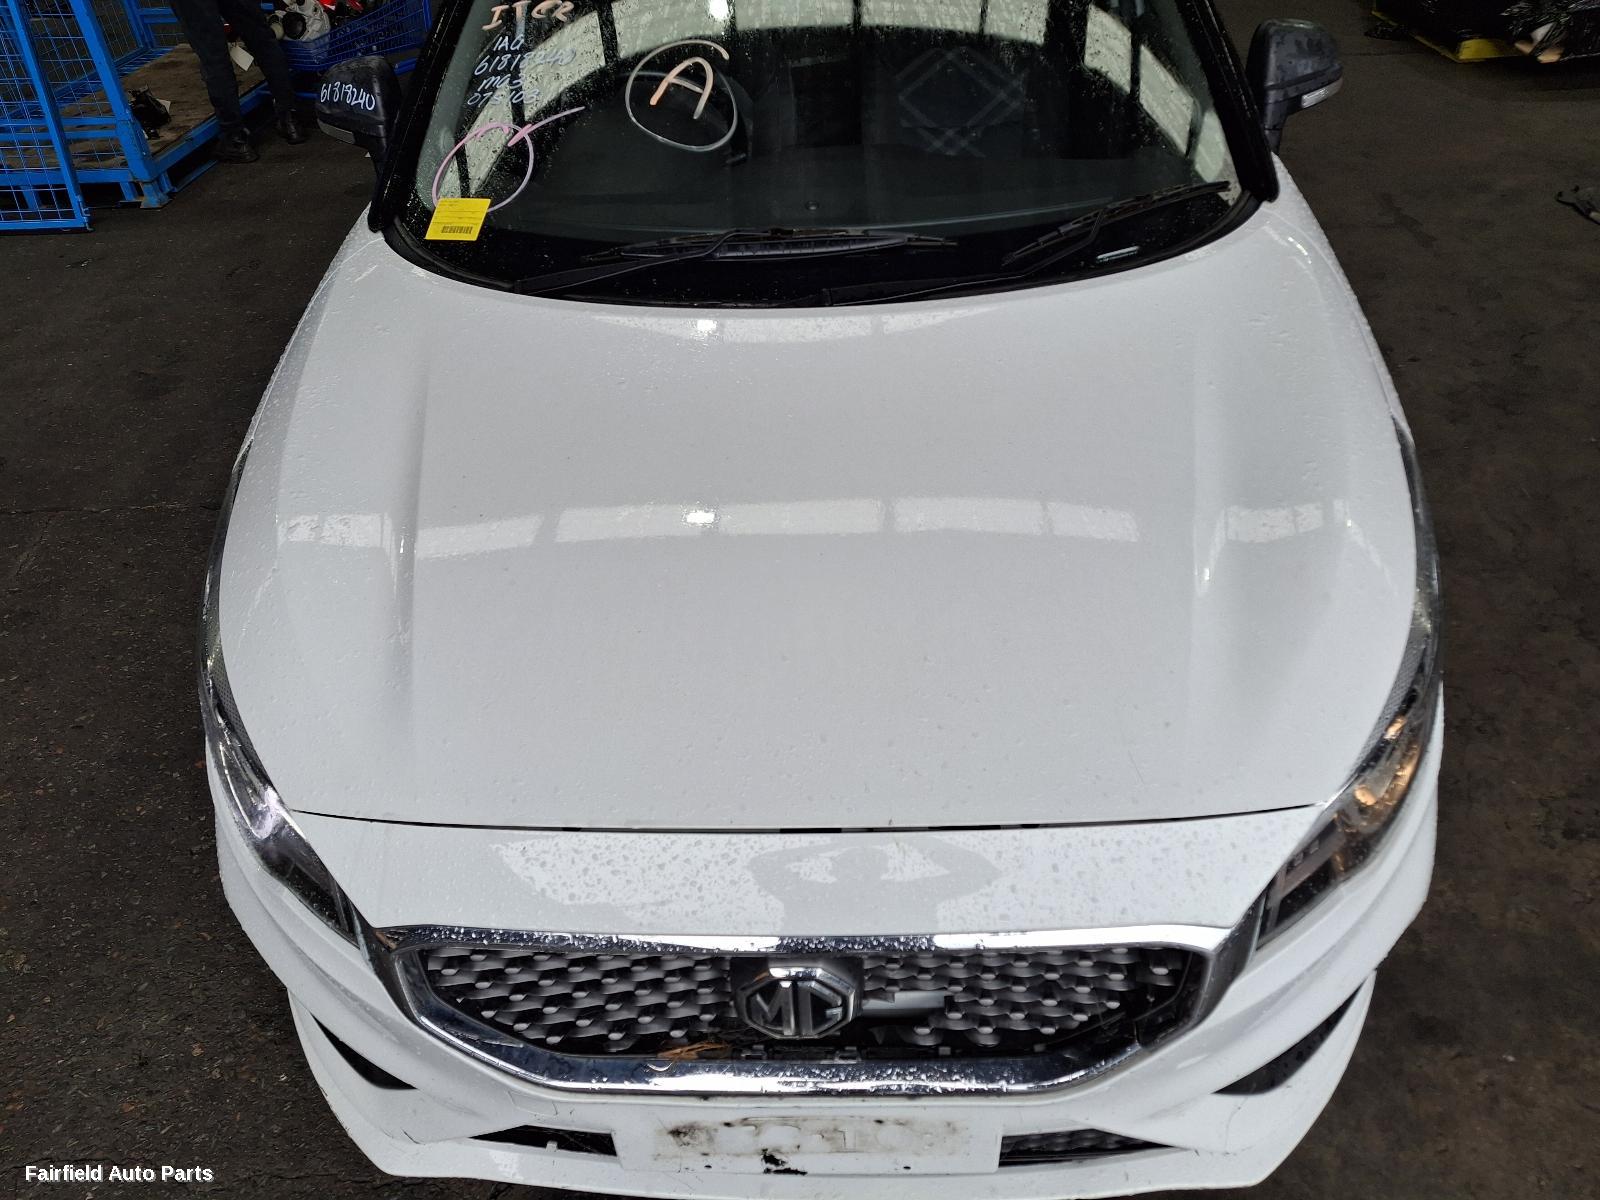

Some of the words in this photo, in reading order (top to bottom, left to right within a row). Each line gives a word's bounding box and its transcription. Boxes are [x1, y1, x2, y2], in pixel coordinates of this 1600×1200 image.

[320, 81, 376, 111] 61818240
[649, 56, 714, 120] A
[747, 980, 843, 1037] MG
